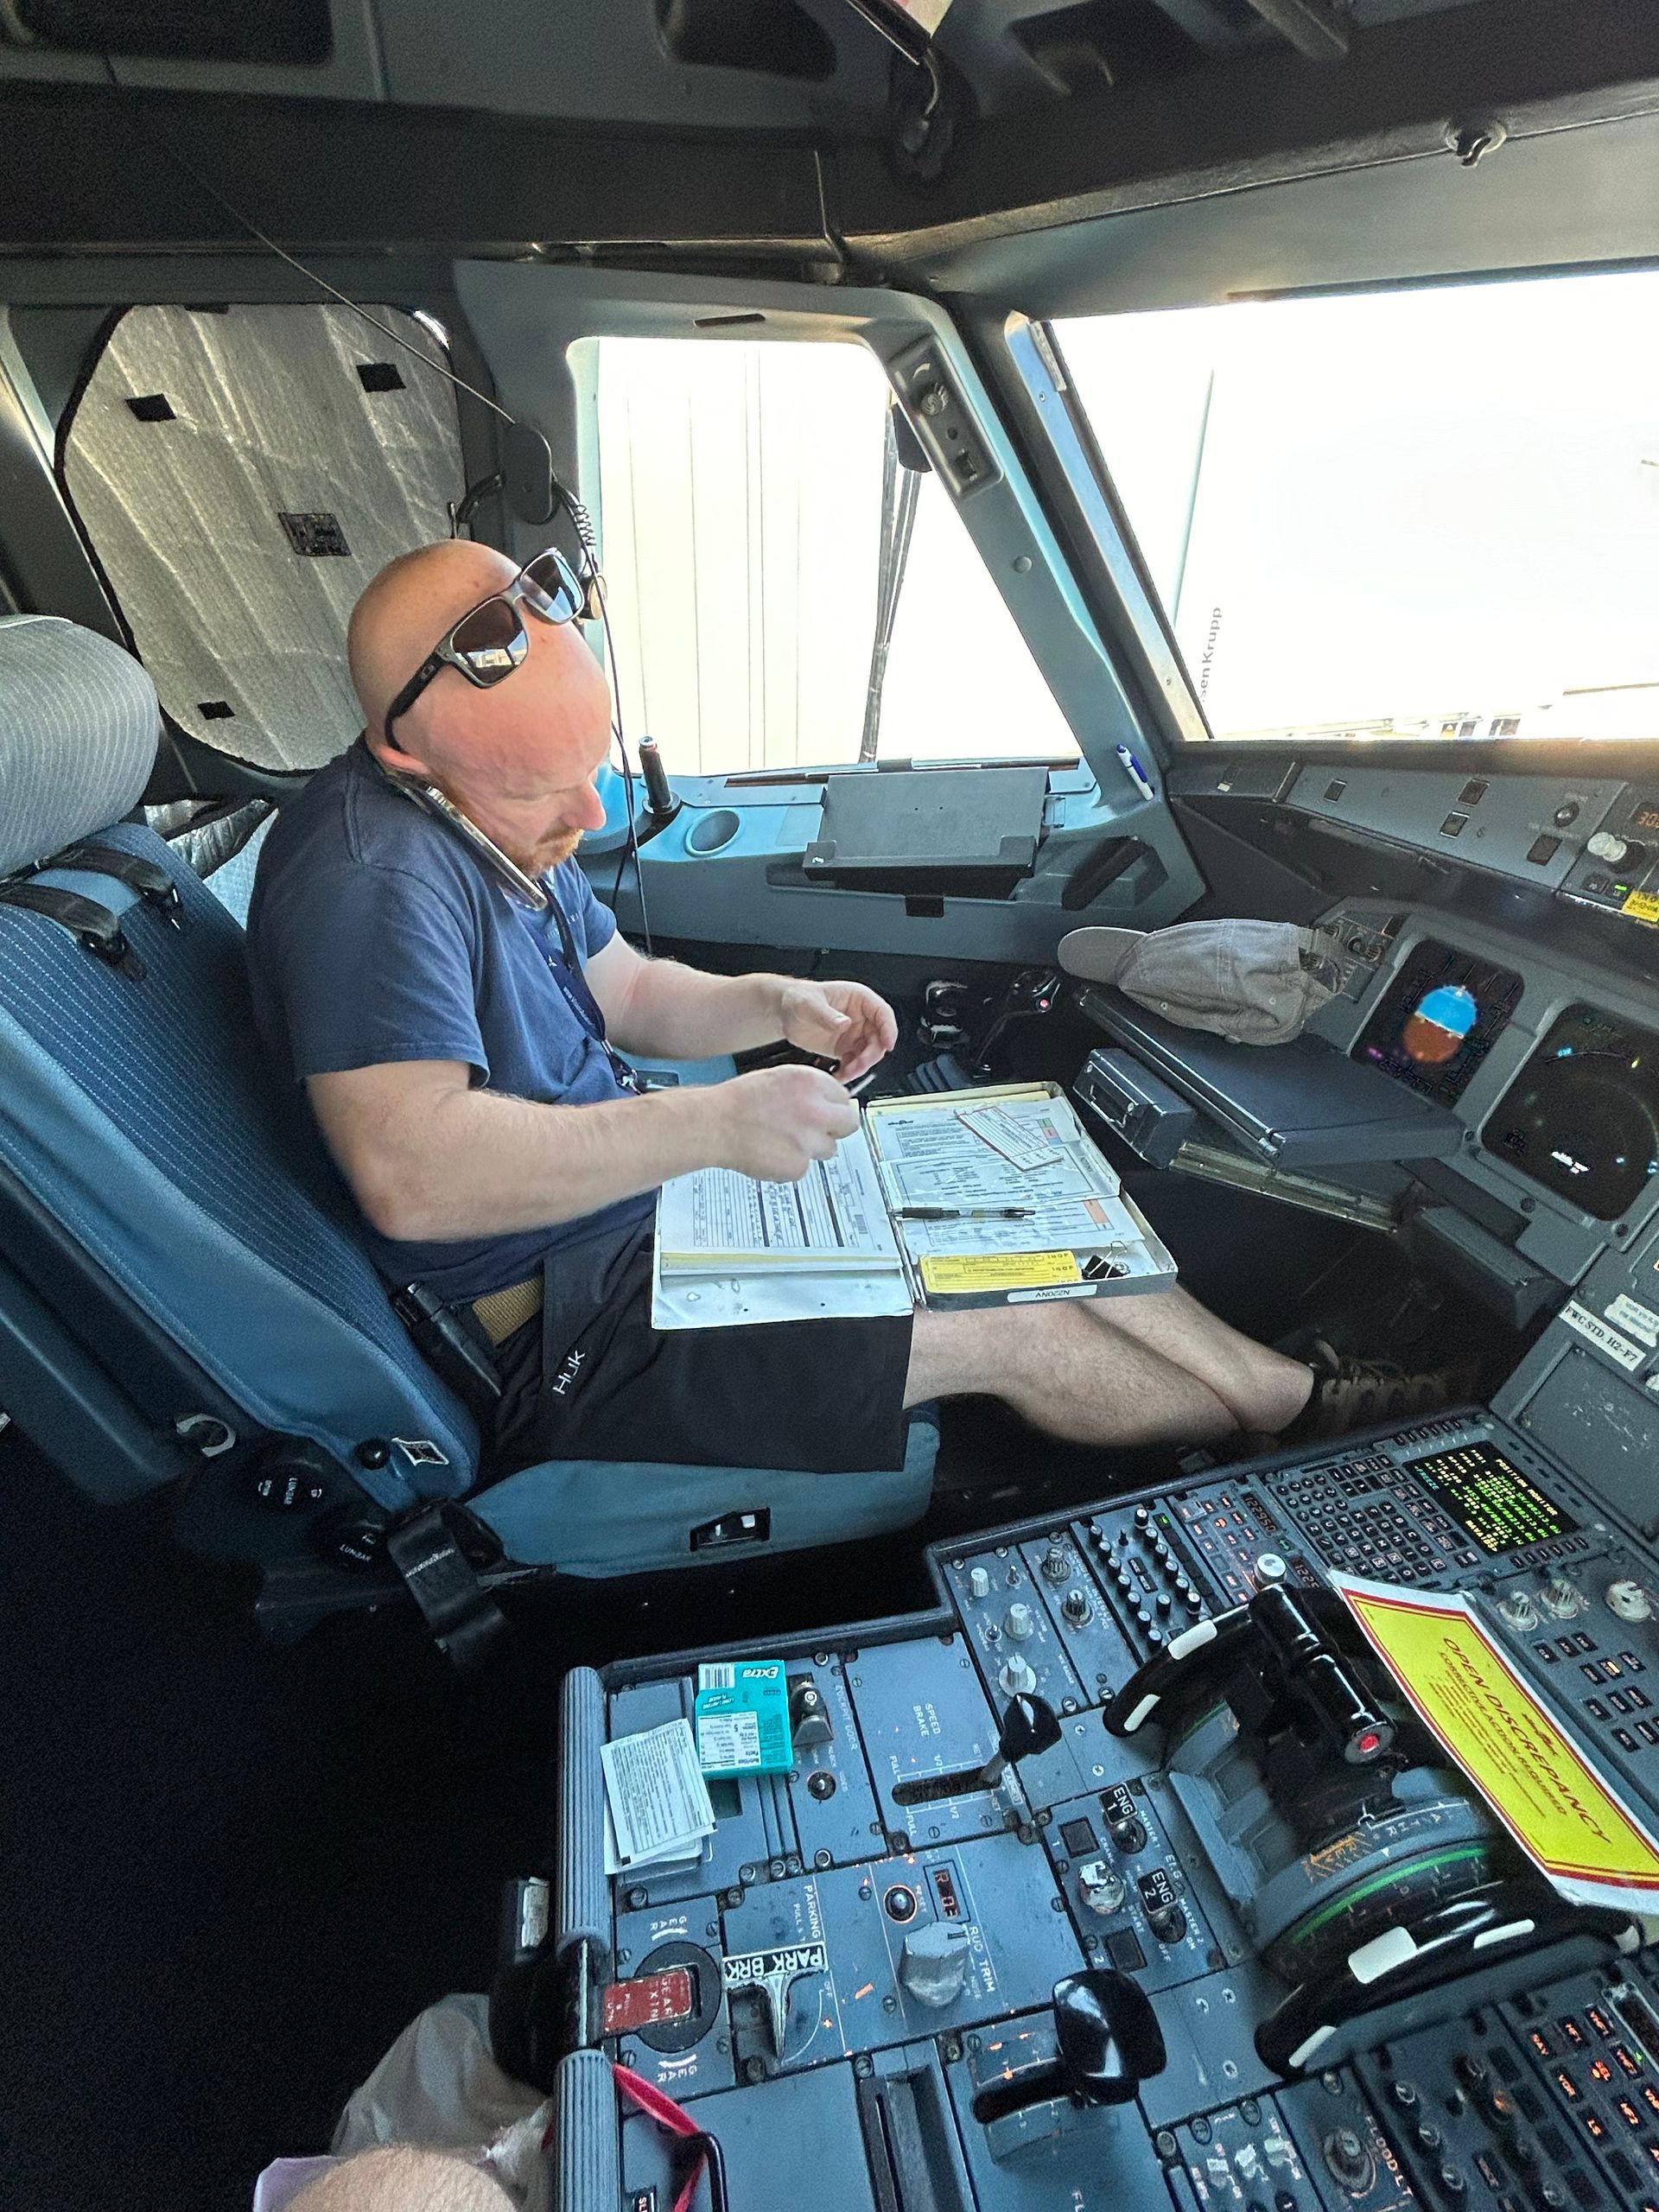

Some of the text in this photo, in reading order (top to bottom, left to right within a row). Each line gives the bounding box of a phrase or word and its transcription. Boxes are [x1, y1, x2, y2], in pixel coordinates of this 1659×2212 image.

[1201, 606, 1224, 664] Krupp
[1035, 1288, 1071, 1300] N220NV
[1564, 1306, 1586, 1325] FWC
[549, 1346, 588, 1395] HUK
[1496, 1459, 1558, 1516] POSITION MONITOR
[741, 1665, 779, 1678] Extra
[912, 1705, 929, 1737] BRAKE
[924, 1702, 940, 1735] SPEED
[1444, 1637, 1490, 1690] OPEN
[1485, 1693, 1612, 1844] DISCREPANCY
[888, 1755, 900, 1775] FULL
[1106, 1802, 1116, 1810] 1
[1112, 1786, 1134, 1815] ENG
[905, 1814, 918, 1836] FULL
[1142, 1886, 1156, 1899] 2
[1150, 1871, 1174, 1904] ENG
[650, 1914, 688, 1931] GEAR
[803, 1884, 821, 1938] PARKING
[724, 1946, 823, 1981] PARK BRK
[968, 1925, 995, 1993] RUD TRIM
[1093, 1954, 1104, 1964] 2
[658, 2065, 698, 2083] GEAR
[1361, 2113, 1414, 2201] FLOOD LT
